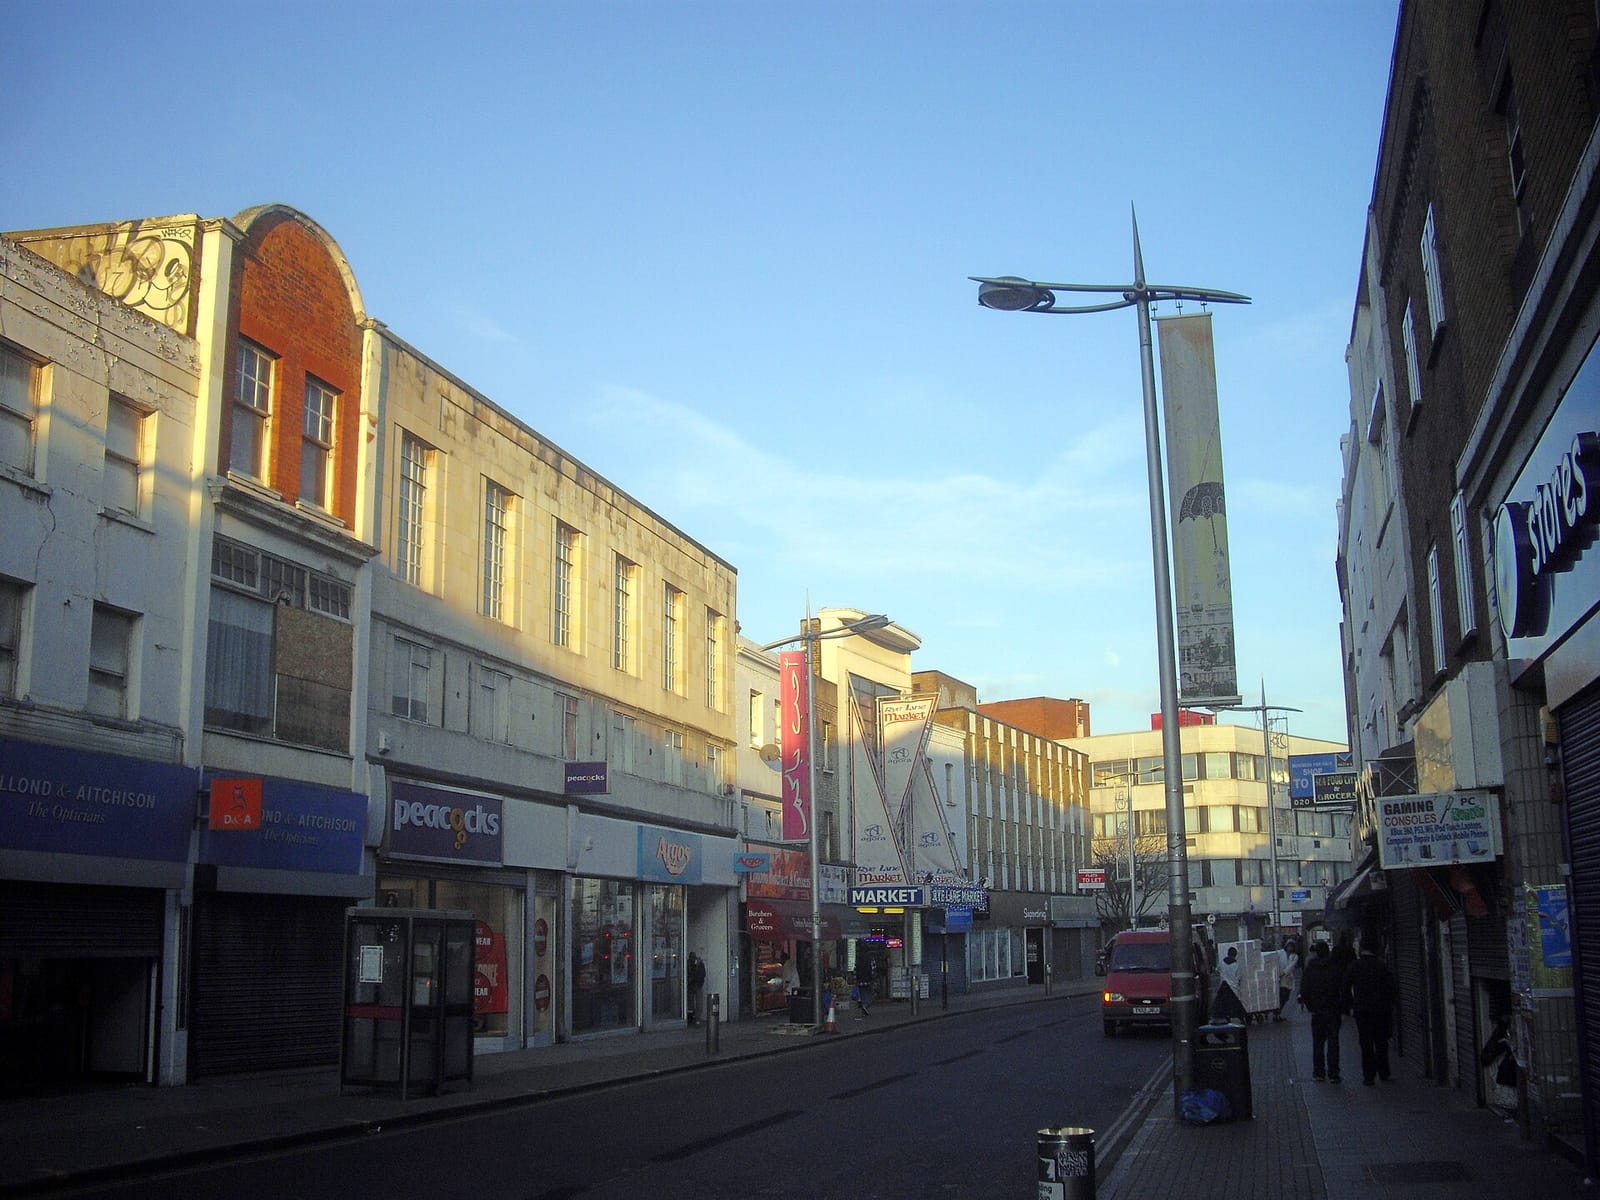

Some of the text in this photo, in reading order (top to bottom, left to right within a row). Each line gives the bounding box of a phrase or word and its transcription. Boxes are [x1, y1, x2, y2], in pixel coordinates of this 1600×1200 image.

[1528, 434, 1588, 576] stores
[885, 712, 926, 722] Market
[567, 774, 605, 783] peacocks
[1293, 778, 1309, 789] TO
[1327, 775, 1343, 785] FOOD
[76, 785, 156, 808] AITCHISON
[1294, 798, 1310, 806] 020
[1461, 797, 1476, 806] PC
[28, 800, 106, 825] The Opticians
[1384, 800, 1434, 816] GAMING
[298, 815, 356, 833] AITCHISON
[394, 799, 499, 836] peacocks
[1384, 813, 1437, 827] CONSOLES
[656, 835, 690, 870] Argos
[737, 856, 765, 868] Argos
[859, 873, 902, 883] Market
[852, 888, 918, 903] MARKET
